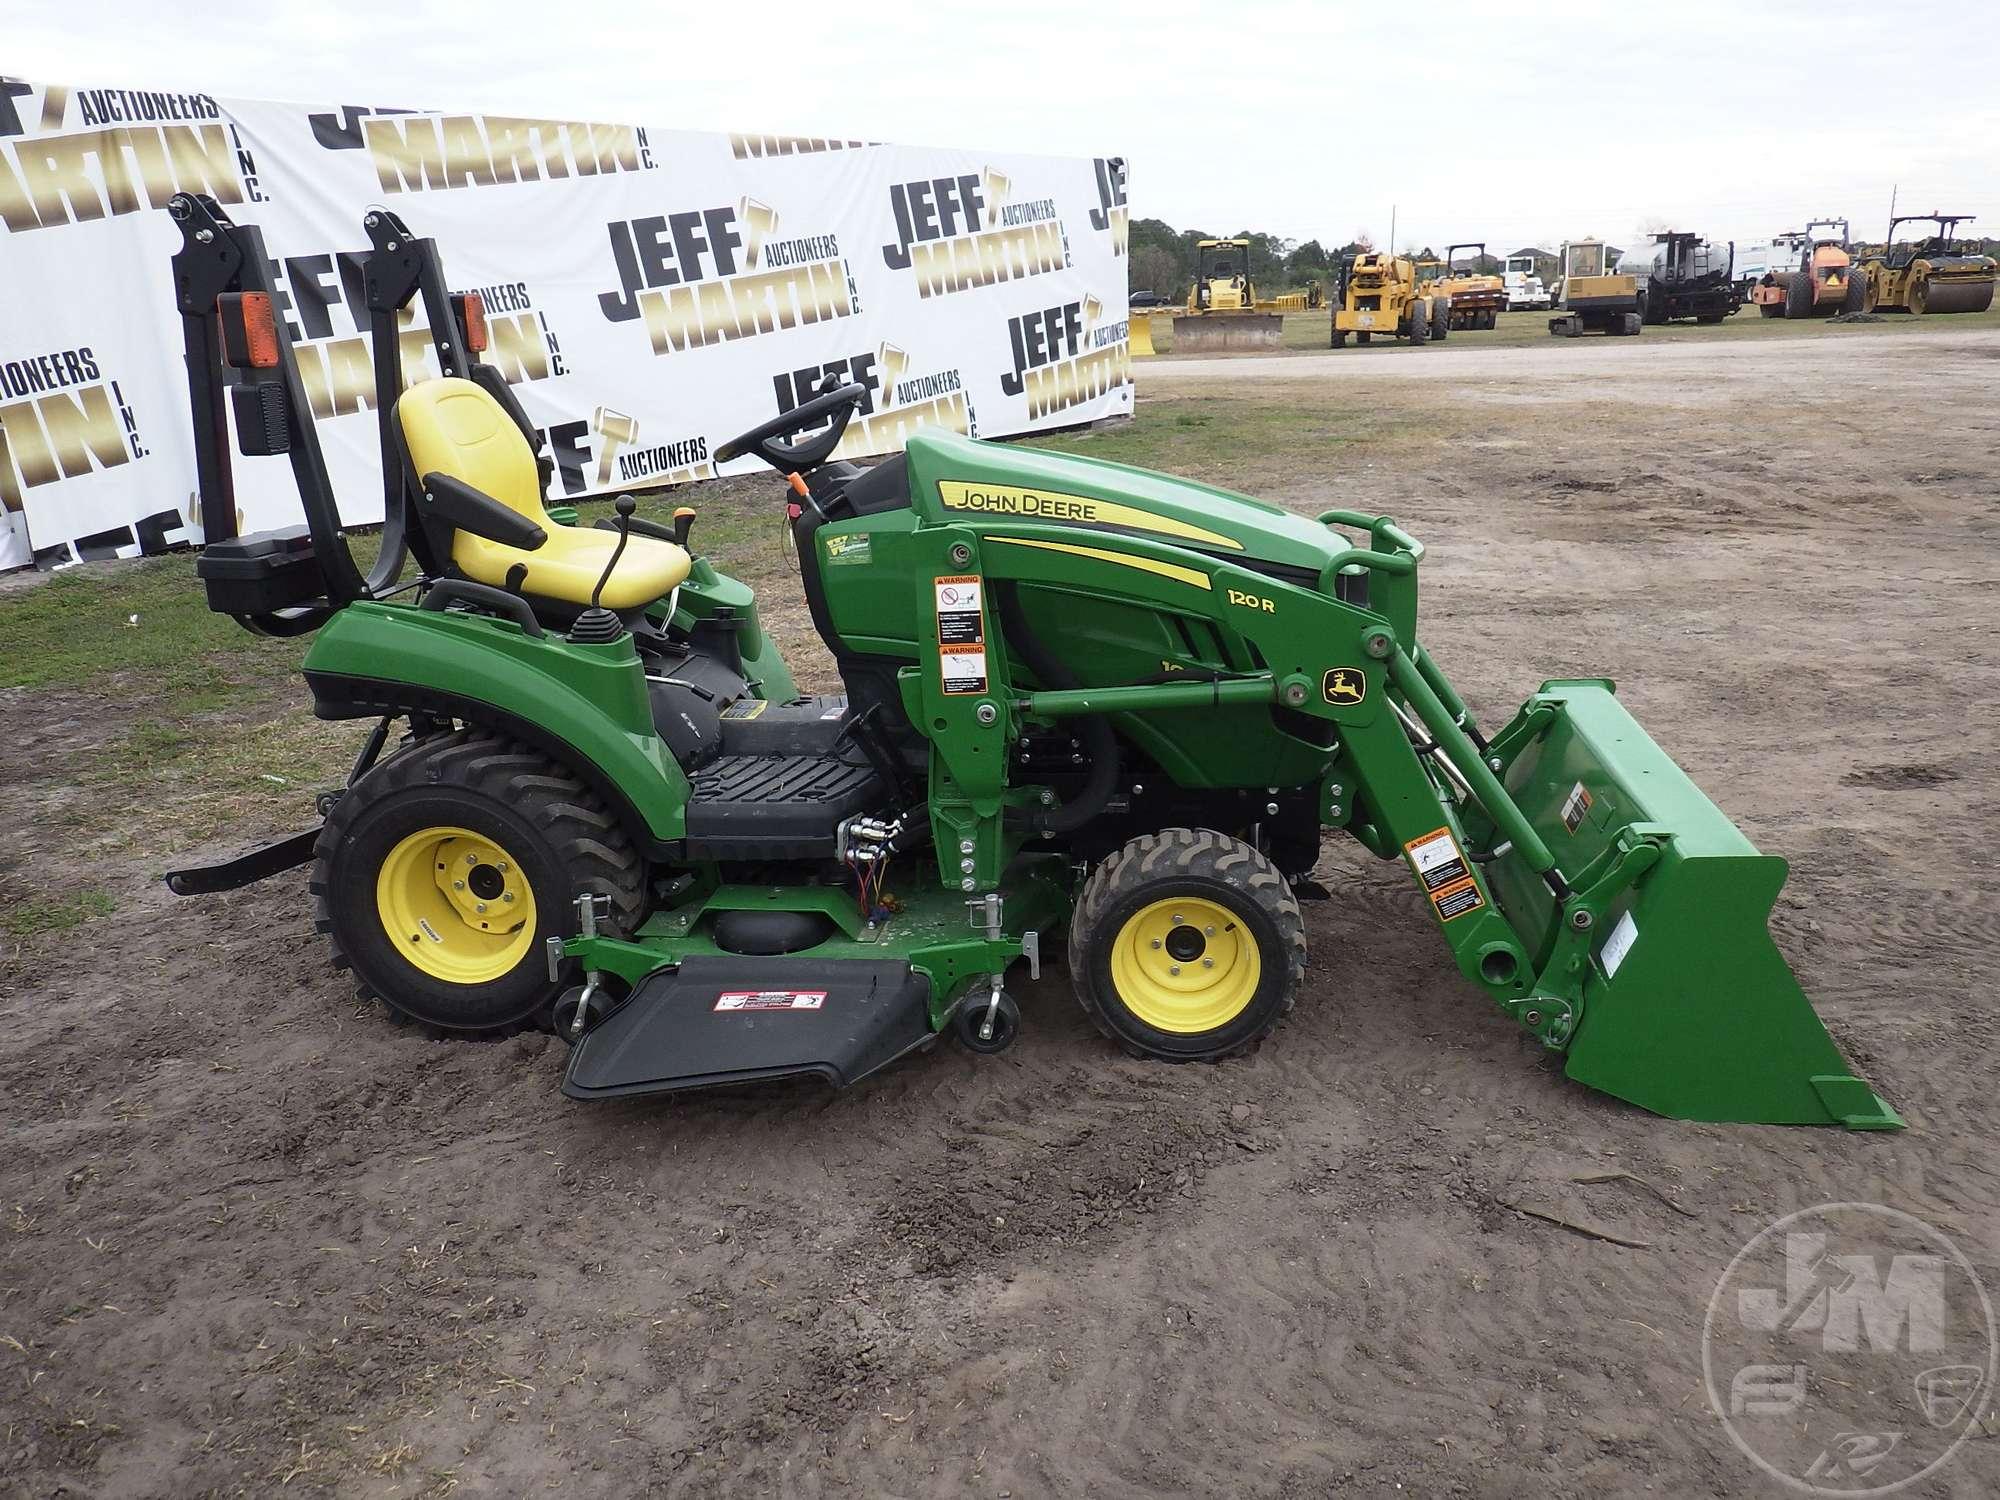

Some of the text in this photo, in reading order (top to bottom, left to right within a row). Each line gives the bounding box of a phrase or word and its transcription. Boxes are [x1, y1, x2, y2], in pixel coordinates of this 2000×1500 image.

[76, 89, 220, 126] AUCTIONEERS
[364, 115, 641, 194] MARTIN
[882, 173, 985, 271] JEFF
[1002, 198, 1057, 227] AUCTIONEERS
[597, 206, 743, 323] JEFF
[765, 234, 840, 268] AUCTIONEERS
[911, 221, 1065, 299] MARTIN
[639, 260, 851, 356] MARTIN
[1000, 301, 1083, 397] JEFF
[897, 368, 961, 404] AUCTIONEERS
[619, 426, 708, 481] AUCTIONEERS
[957, 489, 1097, 520] JOHN DEERE
